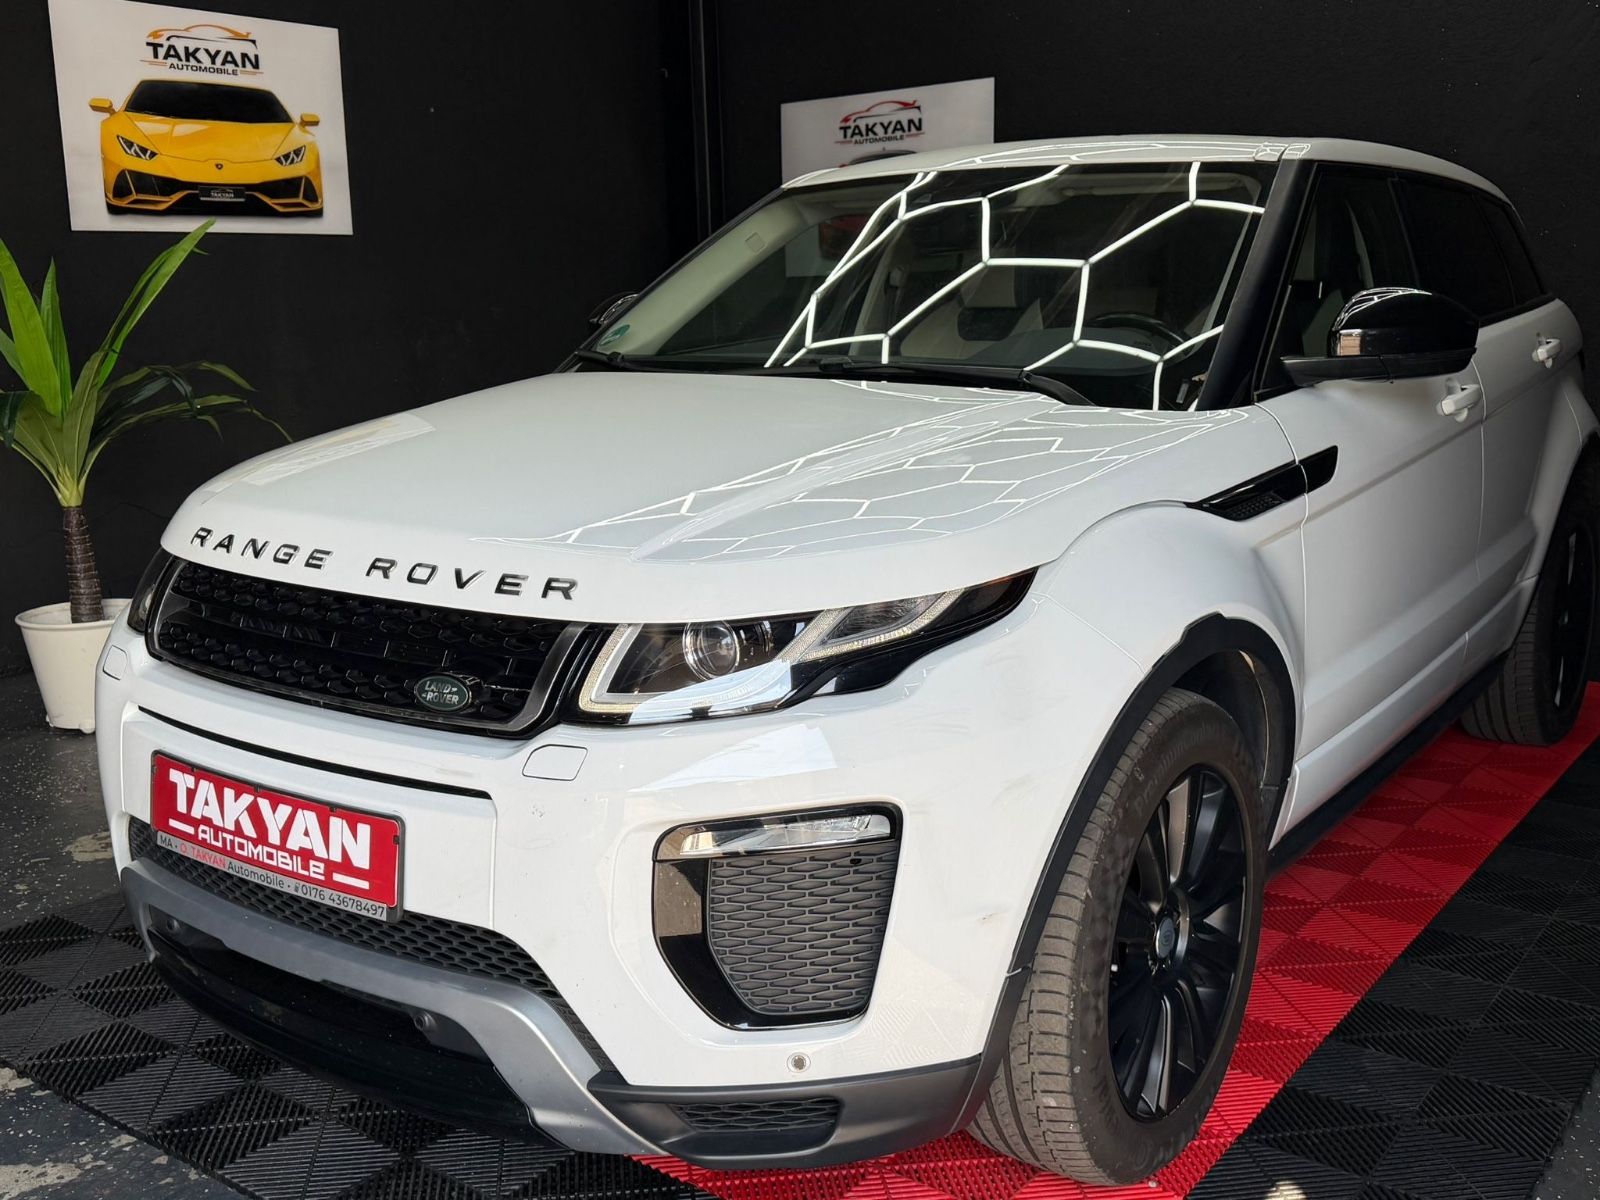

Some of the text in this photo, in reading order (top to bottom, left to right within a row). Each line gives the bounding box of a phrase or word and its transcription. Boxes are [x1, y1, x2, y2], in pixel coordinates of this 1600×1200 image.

[146, 42, 260, 70] TAKYAN
[169, 63, 239, 76] AUTOMOBILE
[839, 118, 922, 139] TAKYAN
[854, 134, 904, 146] AUTOMOBILE
[190, 527, 580, 601] RANGE ROVER
[425, 681, 452, 693] LAND
[426, 692, 459, 705] ROVER
[169, 768, 370, 870] TAKYAN
[198, 825, 325, 880] AUTOMOBILE
[160, 836, 173, 849] MA
[191, 847, 226, 869] TAKYAN
[228, 861, 285, 889] Automobile
[301, 884, 326, 901] 0176
[328, 893, 385, 917] 43678497
